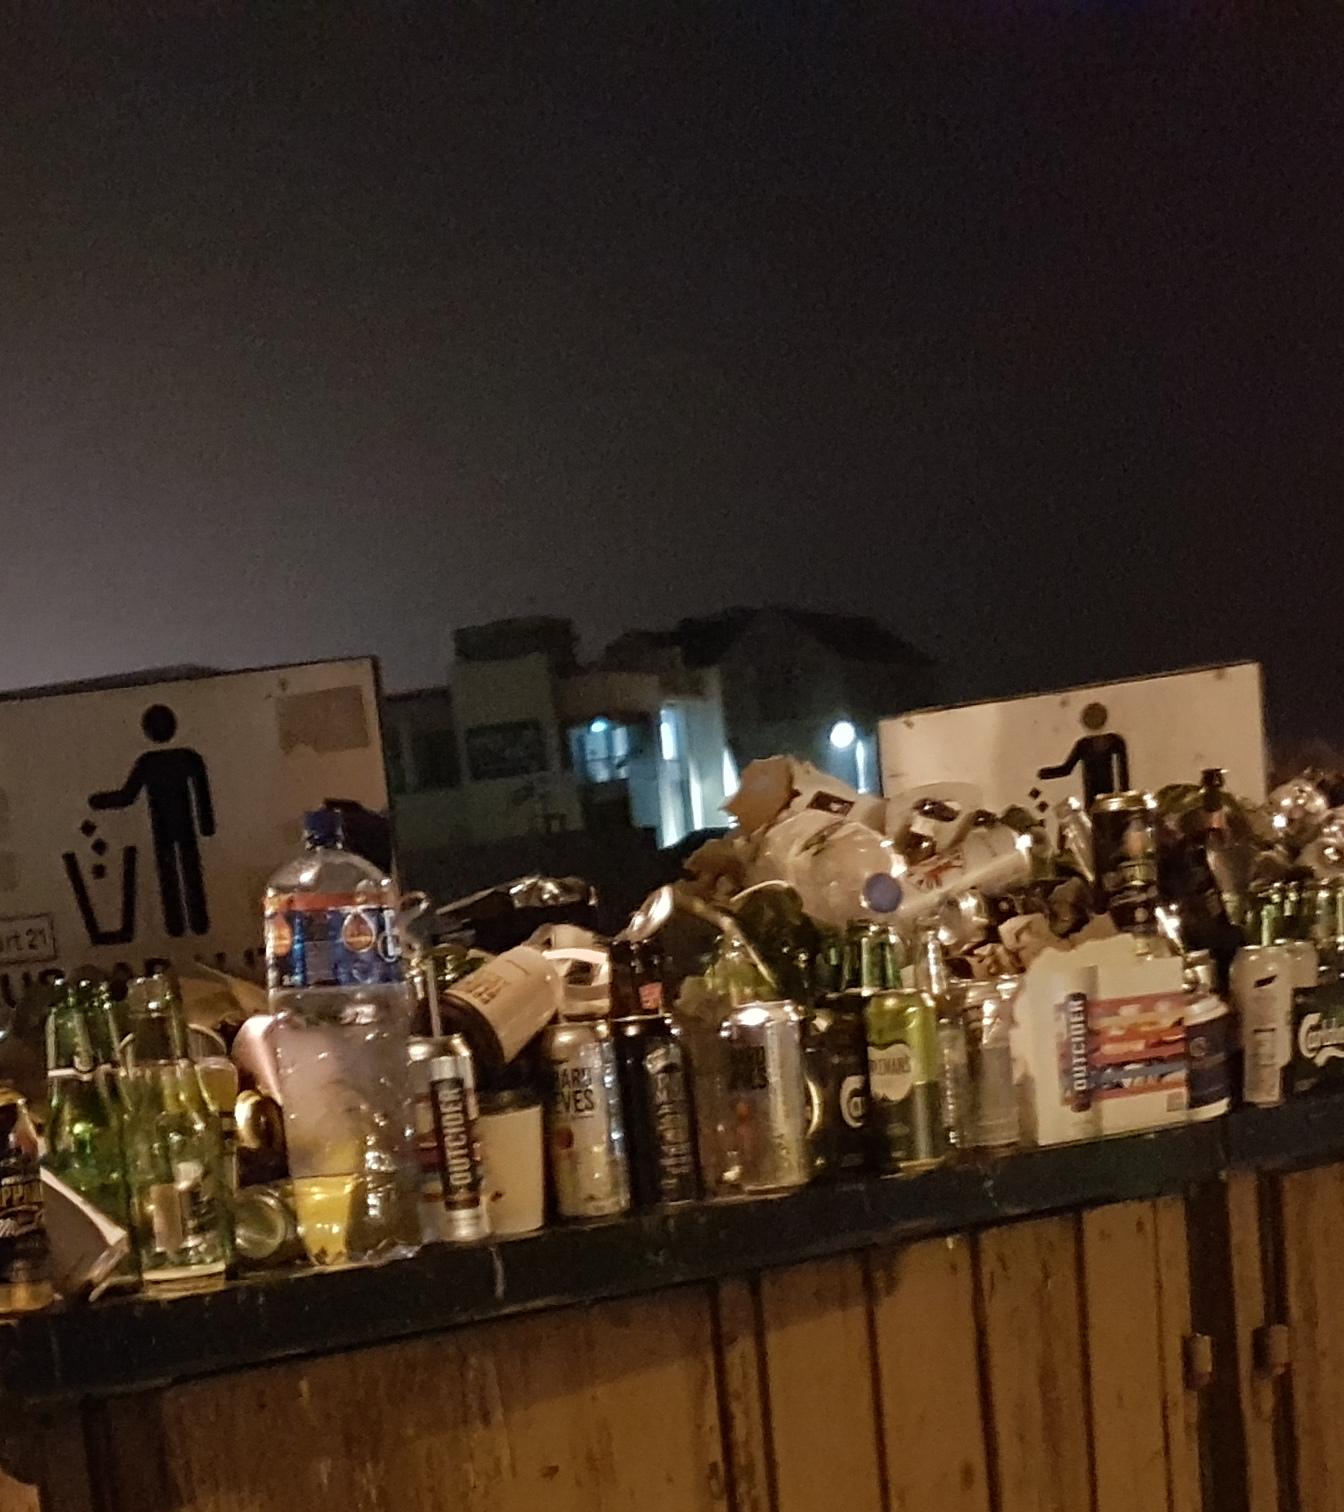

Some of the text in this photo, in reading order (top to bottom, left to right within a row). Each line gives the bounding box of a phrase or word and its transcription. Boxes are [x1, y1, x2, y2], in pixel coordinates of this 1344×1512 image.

[25, 928, 48, 950] 21
[1068, 999, 1088, 1091] OUTCIDER
[438, 1087, 473, 1186] OUTCIDER
